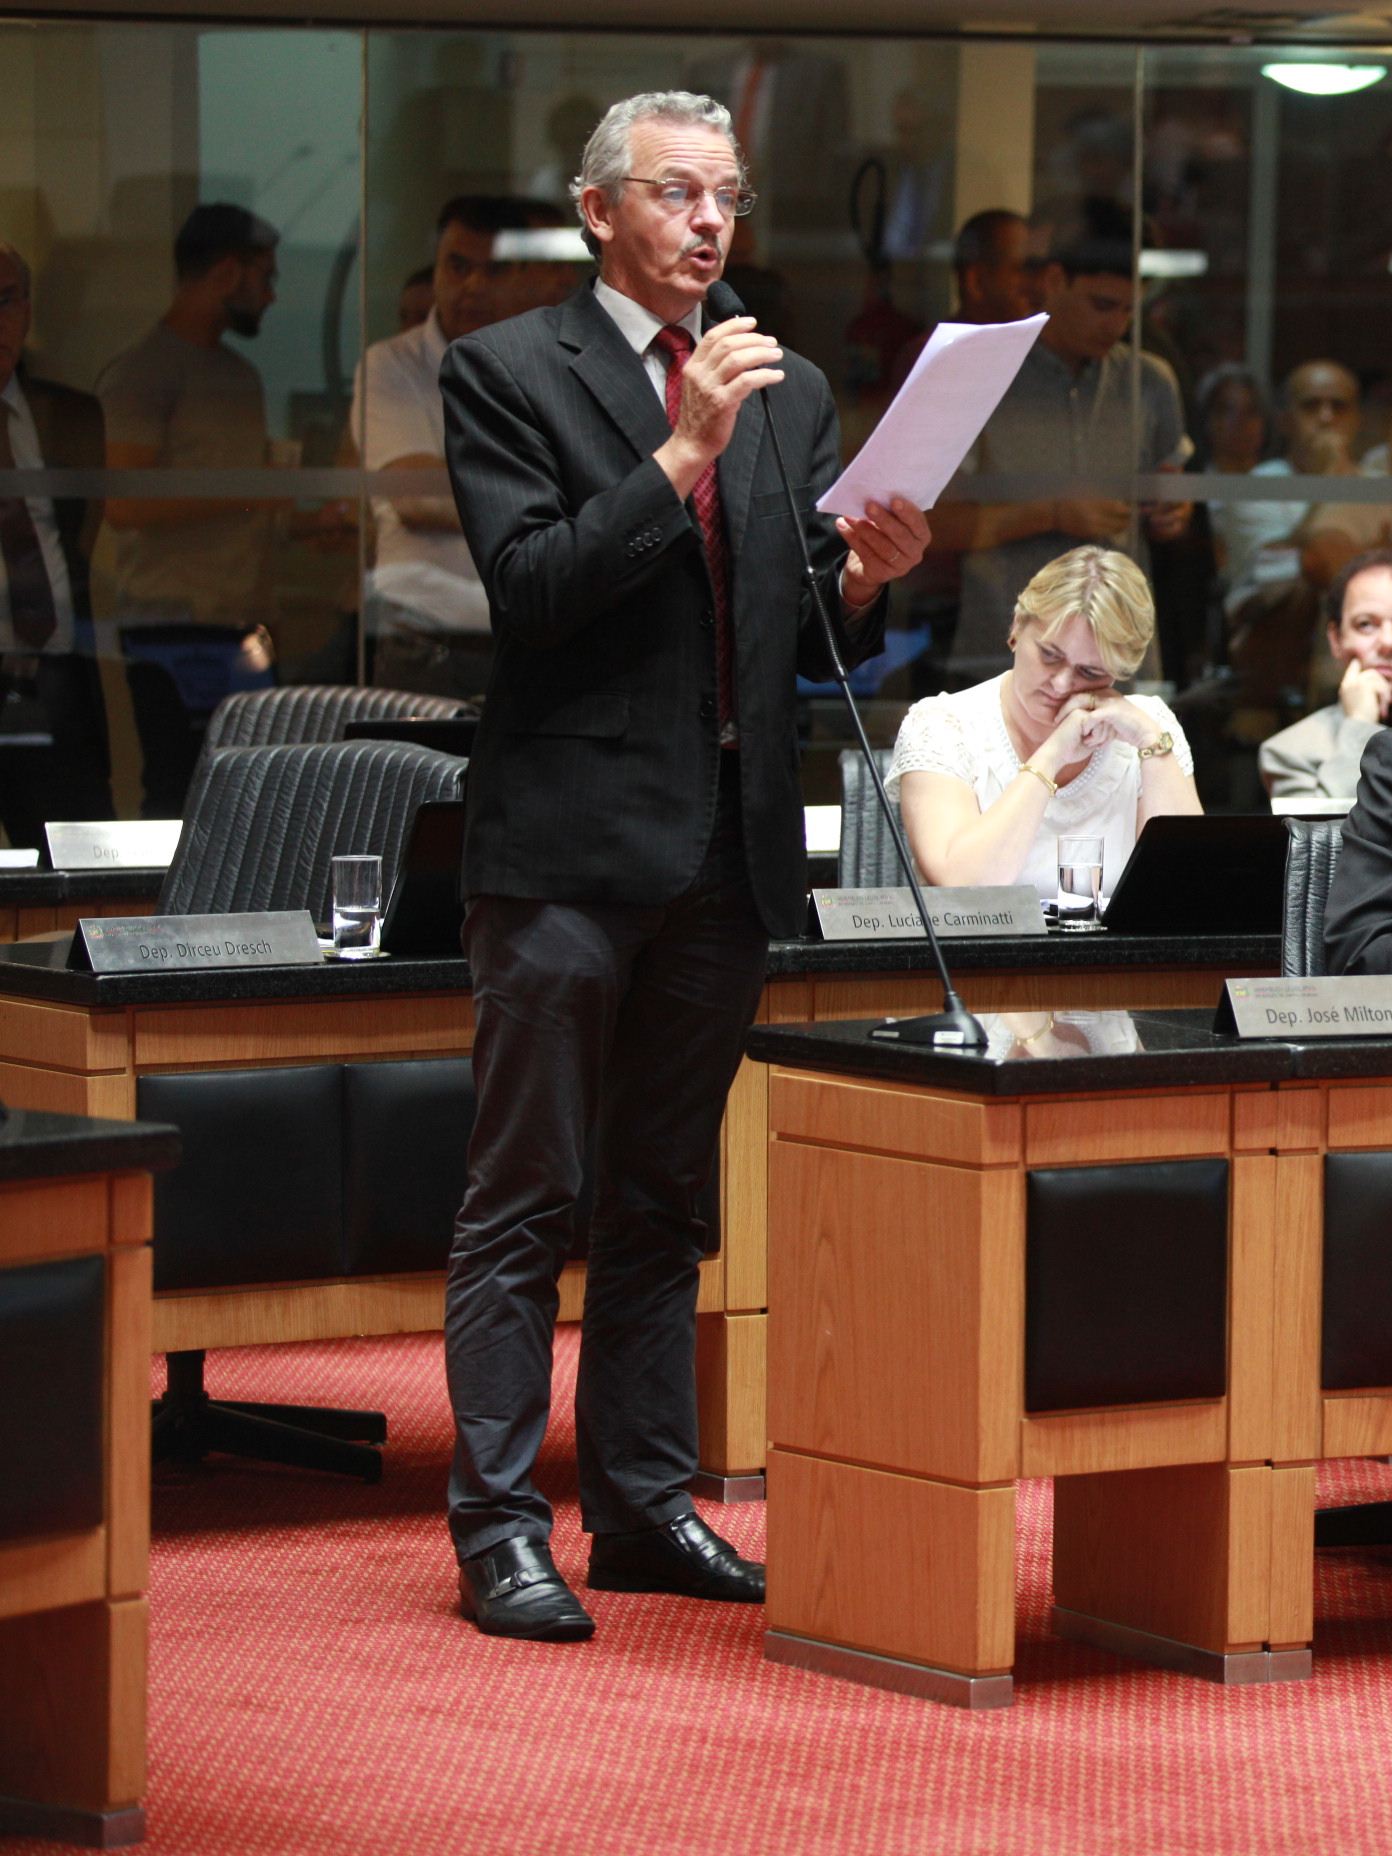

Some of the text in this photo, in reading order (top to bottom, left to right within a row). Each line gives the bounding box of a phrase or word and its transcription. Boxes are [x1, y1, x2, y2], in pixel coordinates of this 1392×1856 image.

[852, 910, 1013, 931] Dep. Luciae Carminatti
[139, 938, 273, 962] Dep. Dirceu Dresch
[1265, 1008, 1302, 1027] Dep.
[1306, 1006, 1340, 1024] José
